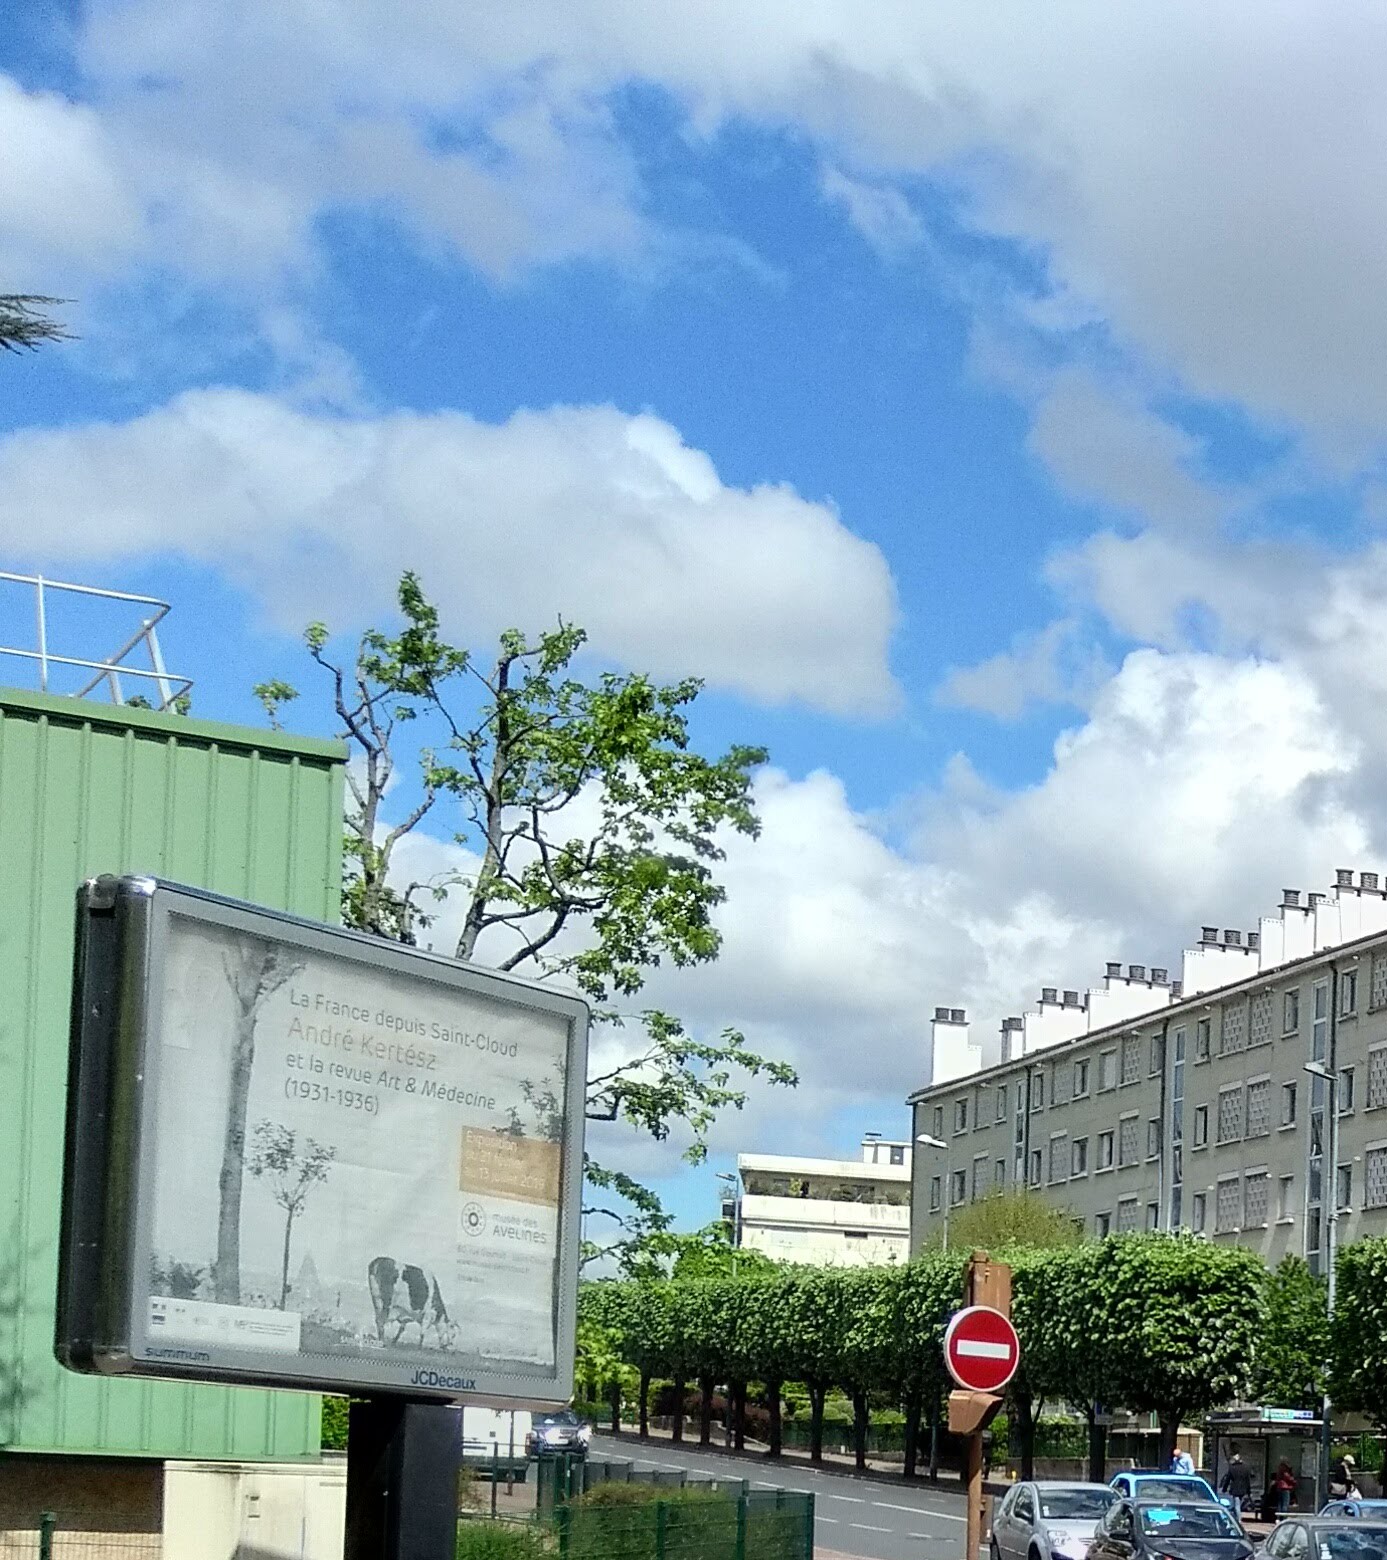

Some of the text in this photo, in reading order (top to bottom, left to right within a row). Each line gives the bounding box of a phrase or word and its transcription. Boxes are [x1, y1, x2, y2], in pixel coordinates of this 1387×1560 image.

[288, 1017, 437, 1071] André Kertész
[290, 989, 518, 1058] La France depuis Saint-Cloud
[284, 1077, 380, 1116] (1931-1936)
[286, 1053, 496, 1110] et la revue Art & Médecine
[411, 1370, 477, 1391] JCDecaux
